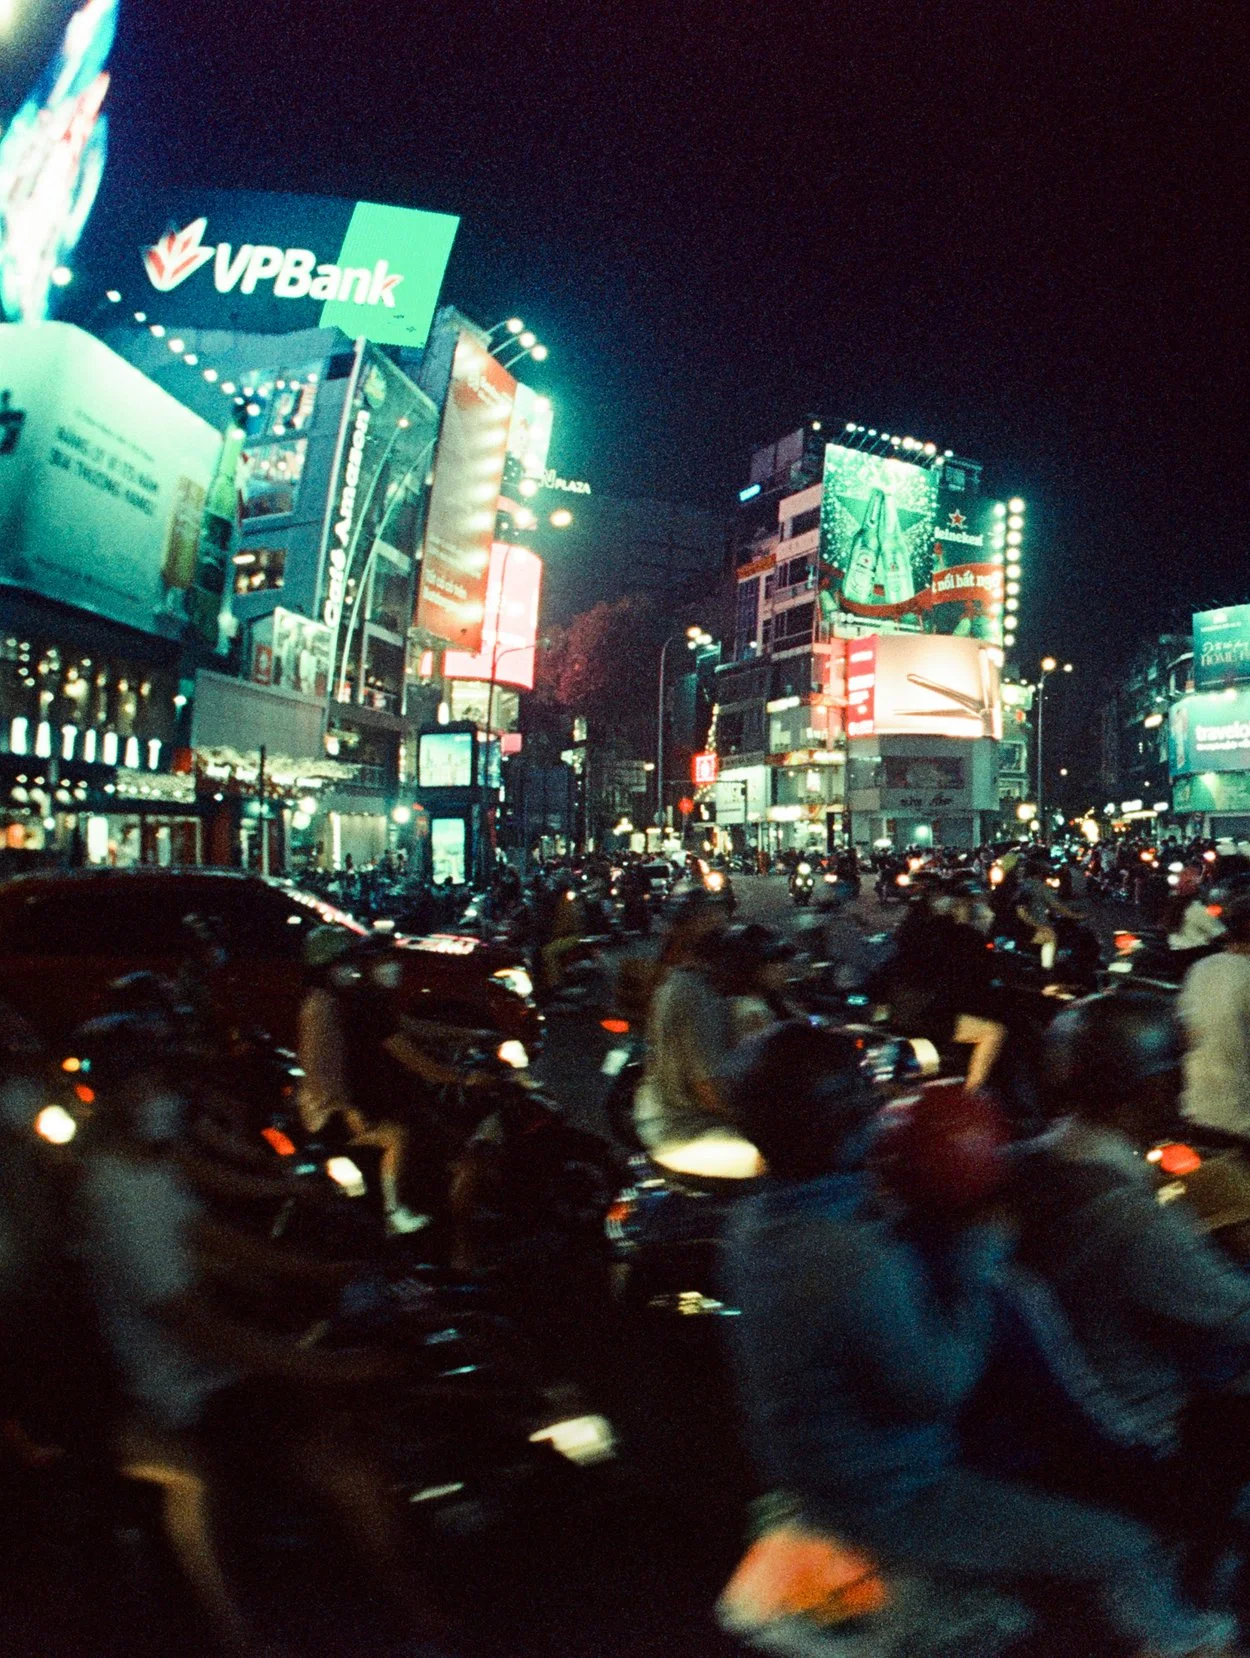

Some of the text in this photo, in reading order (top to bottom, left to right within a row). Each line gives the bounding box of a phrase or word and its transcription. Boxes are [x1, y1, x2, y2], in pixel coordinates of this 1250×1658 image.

[213, 240, 404, 308] VPBank
[334, 409, 370, 547] Amazon
[554, 478, 592, 495] PLAZA
